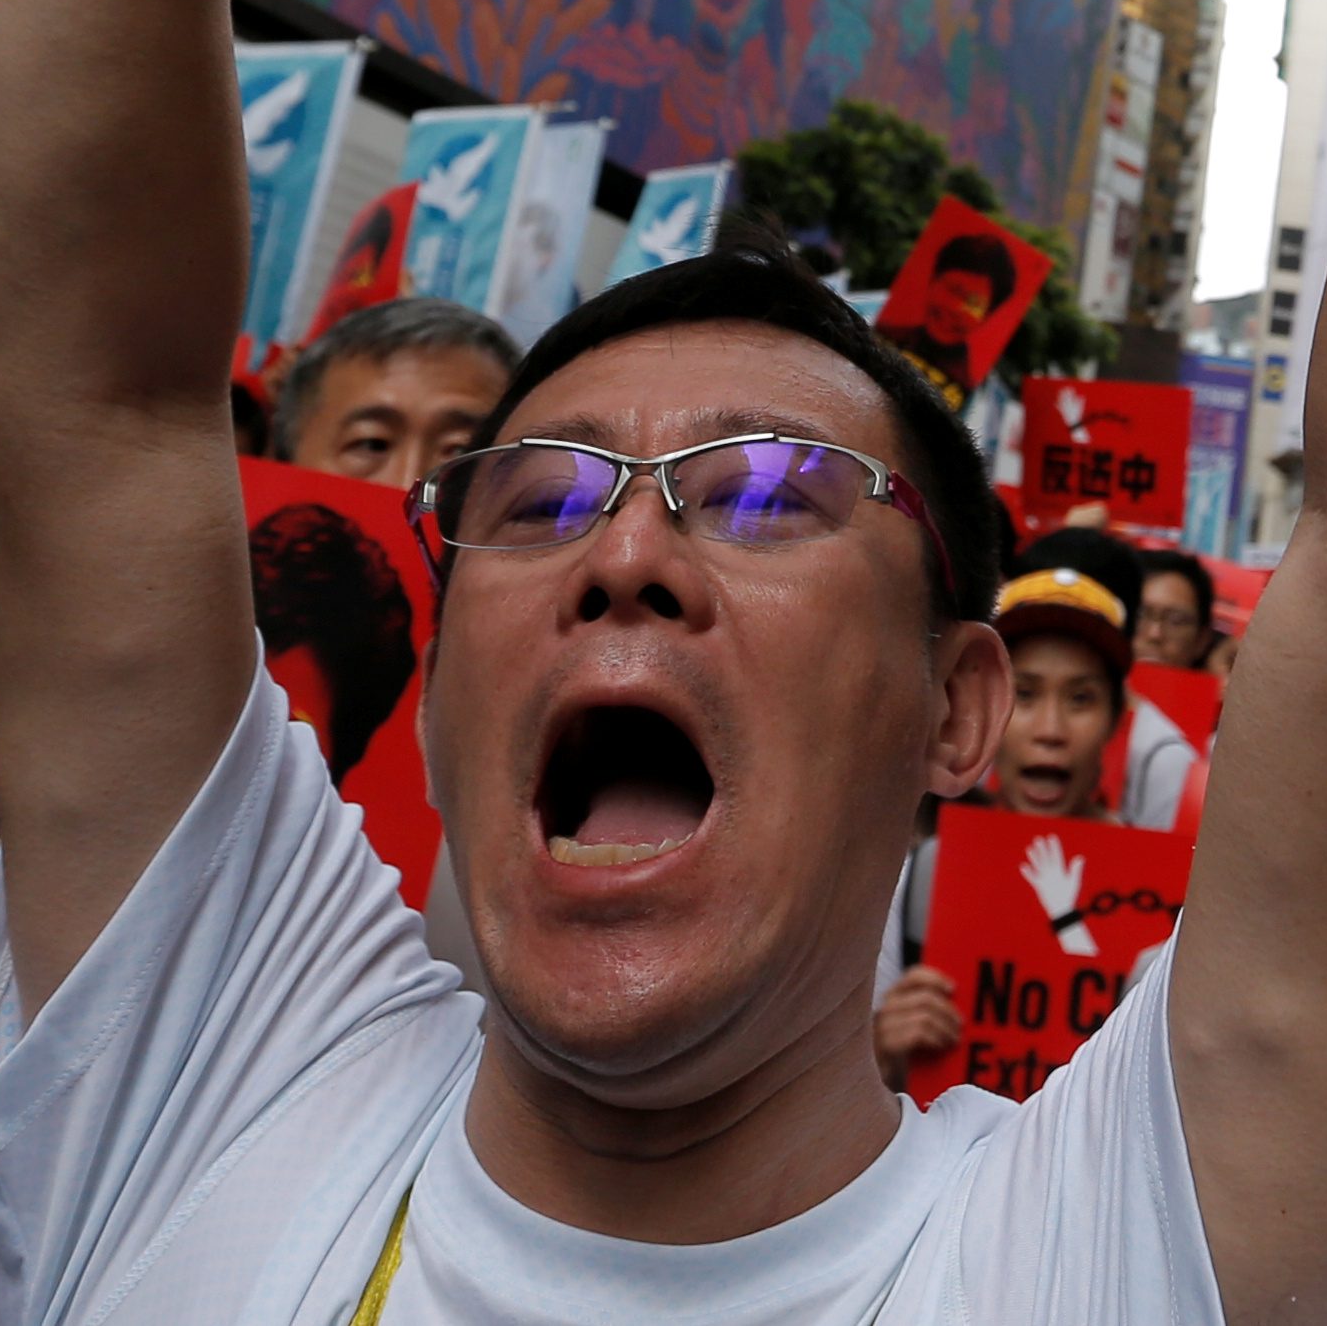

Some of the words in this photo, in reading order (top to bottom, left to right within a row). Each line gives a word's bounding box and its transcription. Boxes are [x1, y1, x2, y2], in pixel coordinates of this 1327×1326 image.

[1042, 443, 1158, 503] 反送中
[973, 959, 1049, 1030] No
